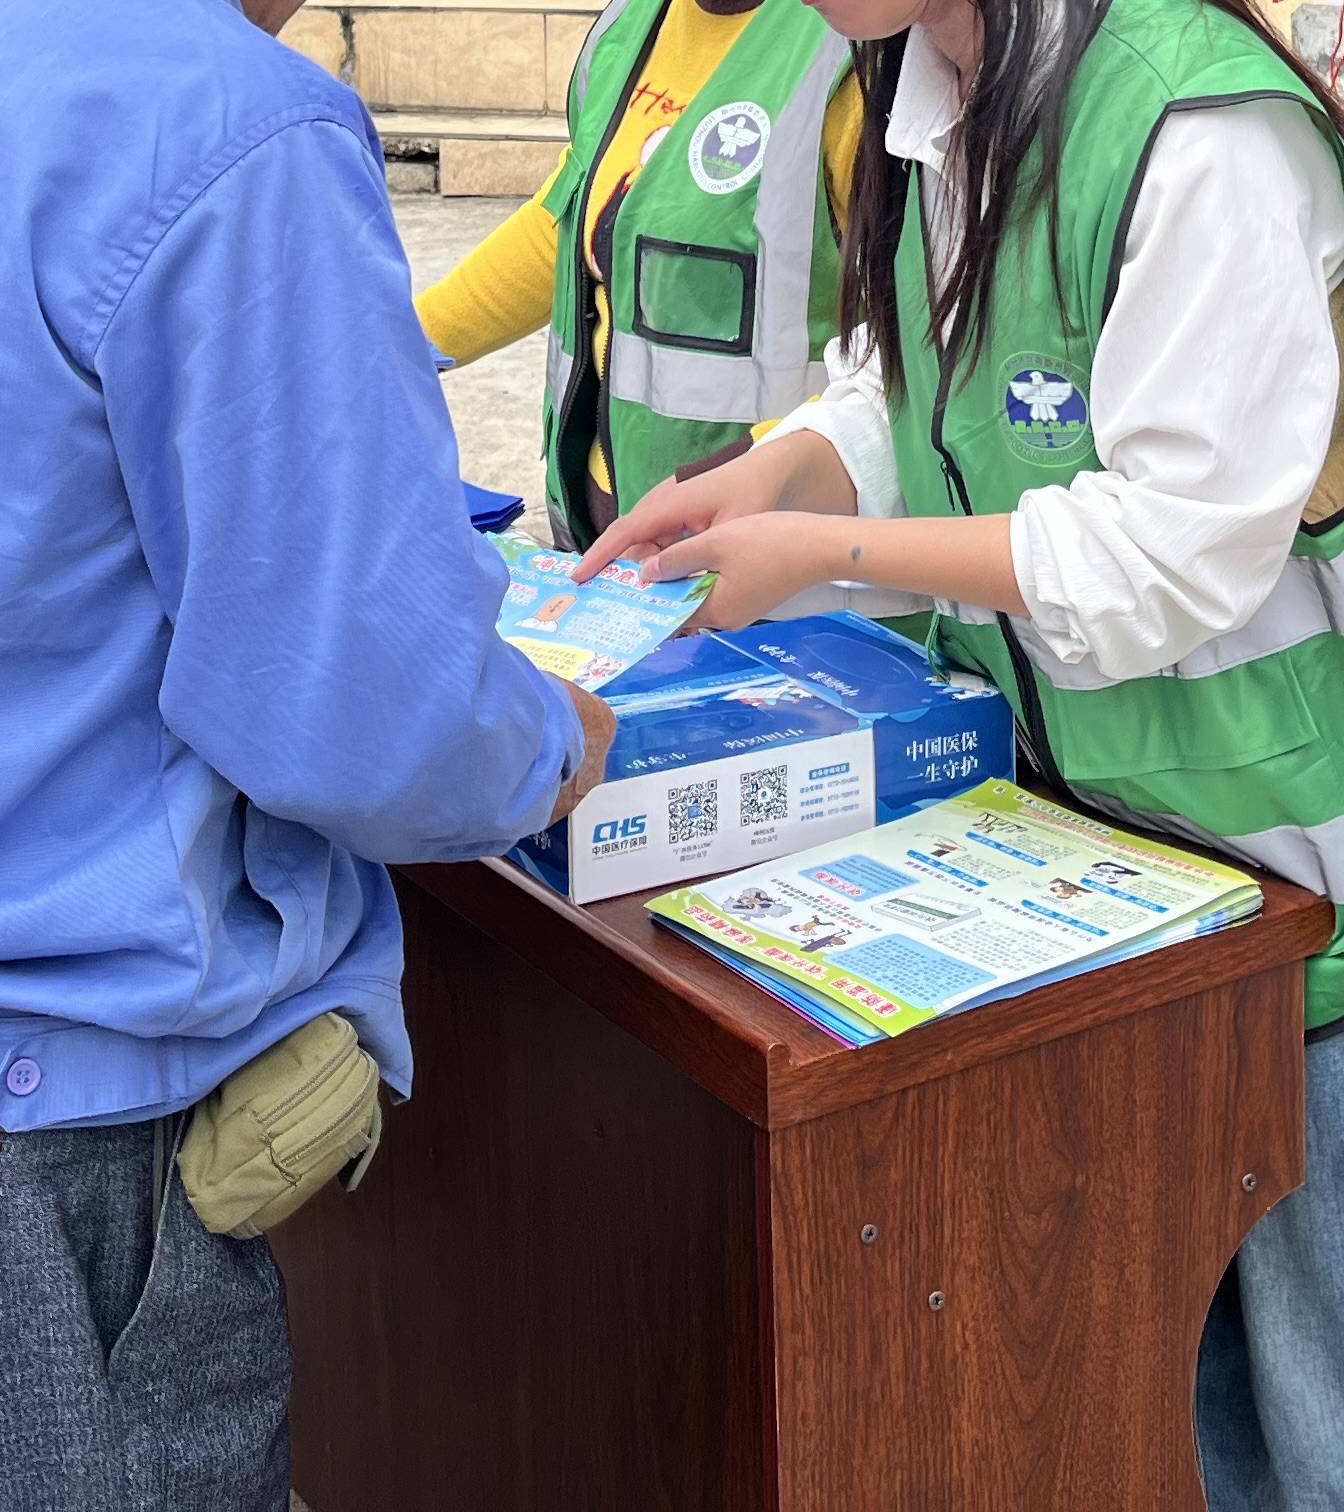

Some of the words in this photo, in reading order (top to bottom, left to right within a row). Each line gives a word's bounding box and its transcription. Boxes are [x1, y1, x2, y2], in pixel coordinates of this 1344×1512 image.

[906, 730, 978, 762] 中国医保
[906, 754, 978, 784] 一生守护
[592, 814, 647, 844] CHS
[592, 835, 647, 856] 中国医疗保障
